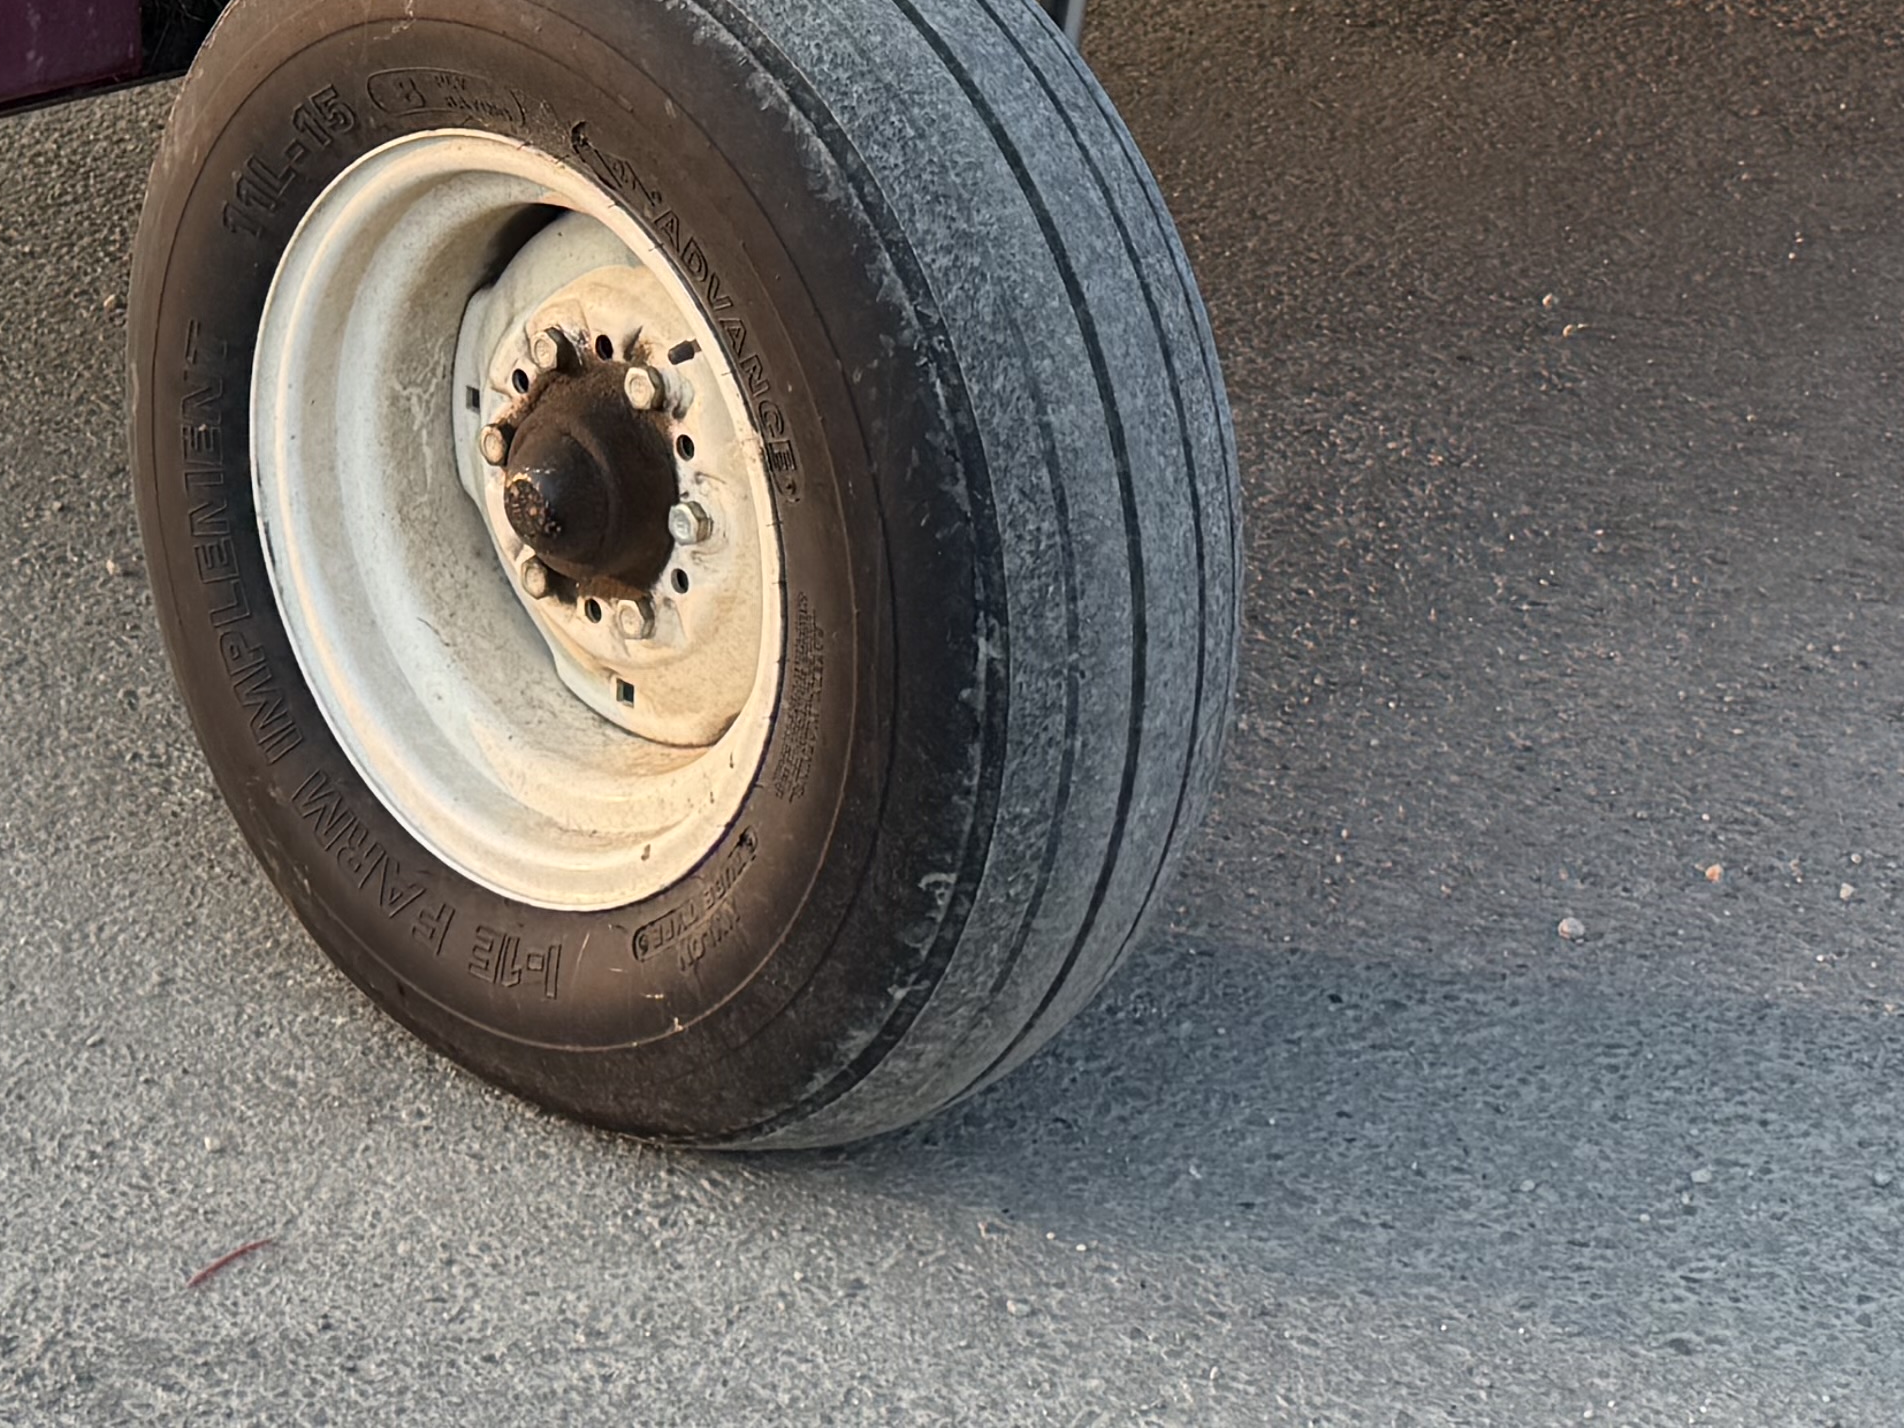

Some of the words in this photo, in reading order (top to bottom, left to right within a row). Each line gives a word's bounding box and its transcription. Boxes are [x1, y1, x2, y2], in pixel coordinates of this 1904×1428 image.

[219, 82, 358, 242] 11L-15
[655, 212, 797, 473] ADVANCE
[181, 319, 304, 764] IMPLEMENT
[292, 768, 456, 957] FARM
